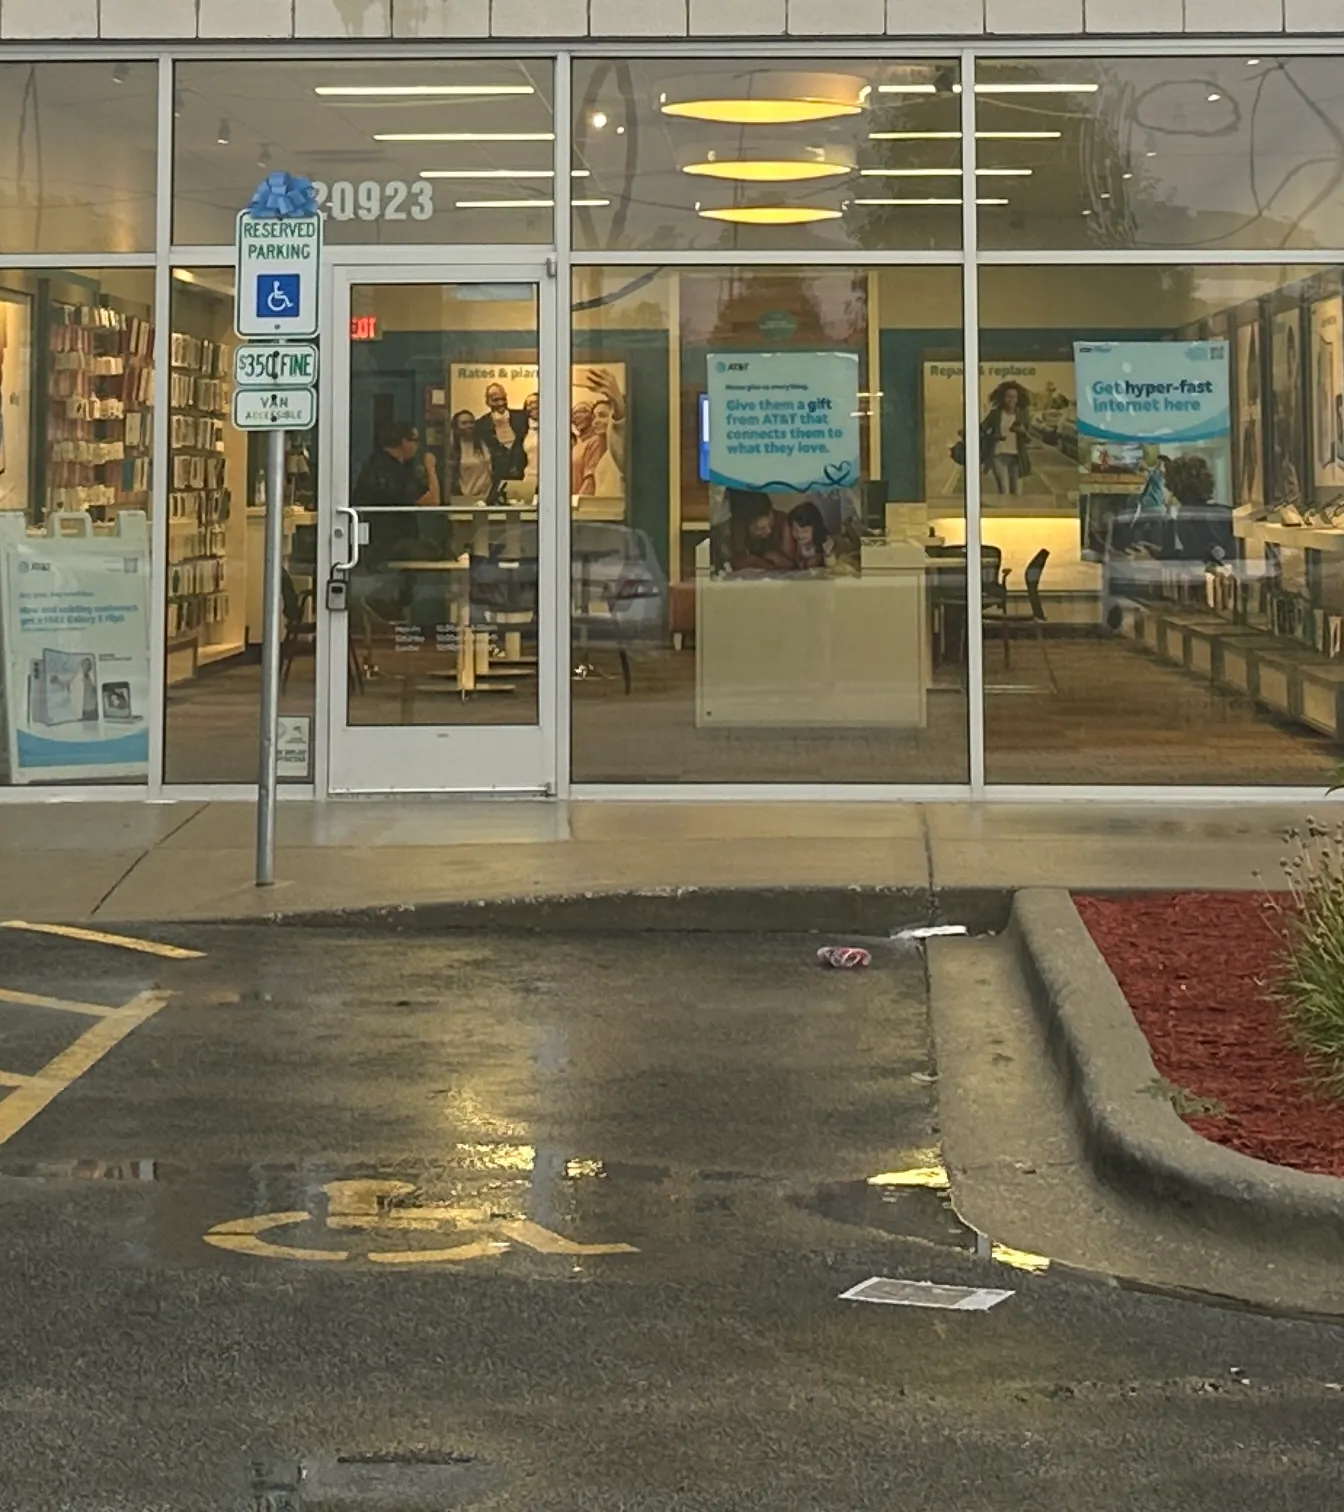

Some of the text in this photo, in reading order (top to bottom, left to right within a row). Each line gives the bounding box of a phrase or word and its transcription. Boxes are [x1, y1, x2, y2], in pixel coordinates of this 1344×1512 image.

[244, 222, 316, 238] RESERVED
[248, 244, 311, 260] PARKING
[239, 353, 313, 379] $350 FINE
[458, 368, 495, 379] Rates
[498, 368, 508, 379] &
[727, 362, 750, 371] AT&T
[988, 364, 1036, 379] replace
[1092, 379, 1213, 398] Get hyper-fast
[260, 396, 289, 409] VAN
[726, 397, 833, 413] Give them a gift
[1093, 397, 1201, 413] internet here
[245, 410, 303, 421] ACCESSIBLE
[726, 413, 829, 425] from AT&T that
[726, 427, 843, 440] connects them to
[726, 441, 831, 456] what they love.
